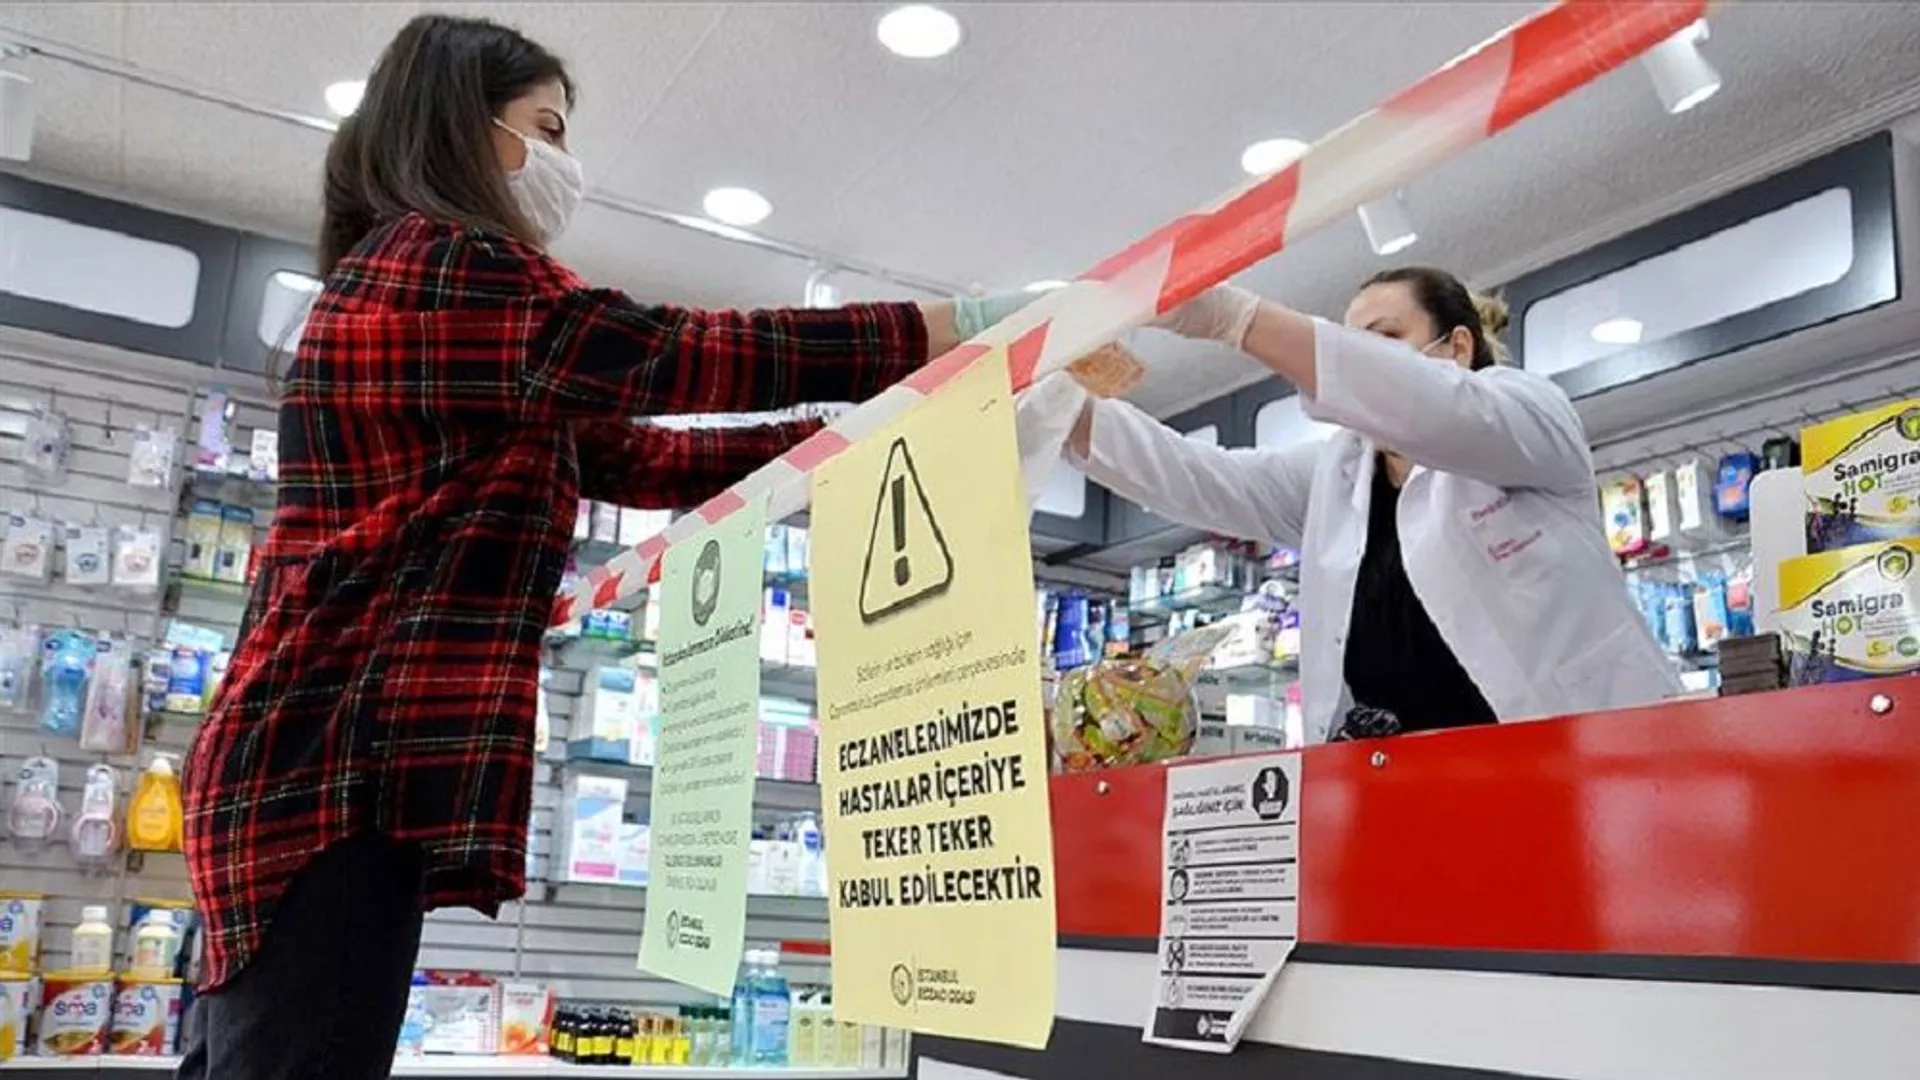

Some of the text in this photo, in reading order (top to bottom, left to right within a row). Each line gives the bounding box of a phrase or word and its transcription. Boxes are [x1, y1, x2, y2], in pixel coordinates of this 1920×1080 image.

[1833, 450, 1920, 481] Samigra
[1843, 471, 1884, 497] HOT
[1811, 593, 1904, 618] Samigra
[1822, 614, 1863, 637] HOT
[839, 700, 1019, 772] ECZANELERİMİZDE
[839, 751, 1026, 816] HASTALAR İÇERİYE
[862, 814, 994, 860] TEKER TEKER
[839, 853, 1043, 909] KABUL EDİLECEKTİR
[54, 999, 97, 1017] sma
